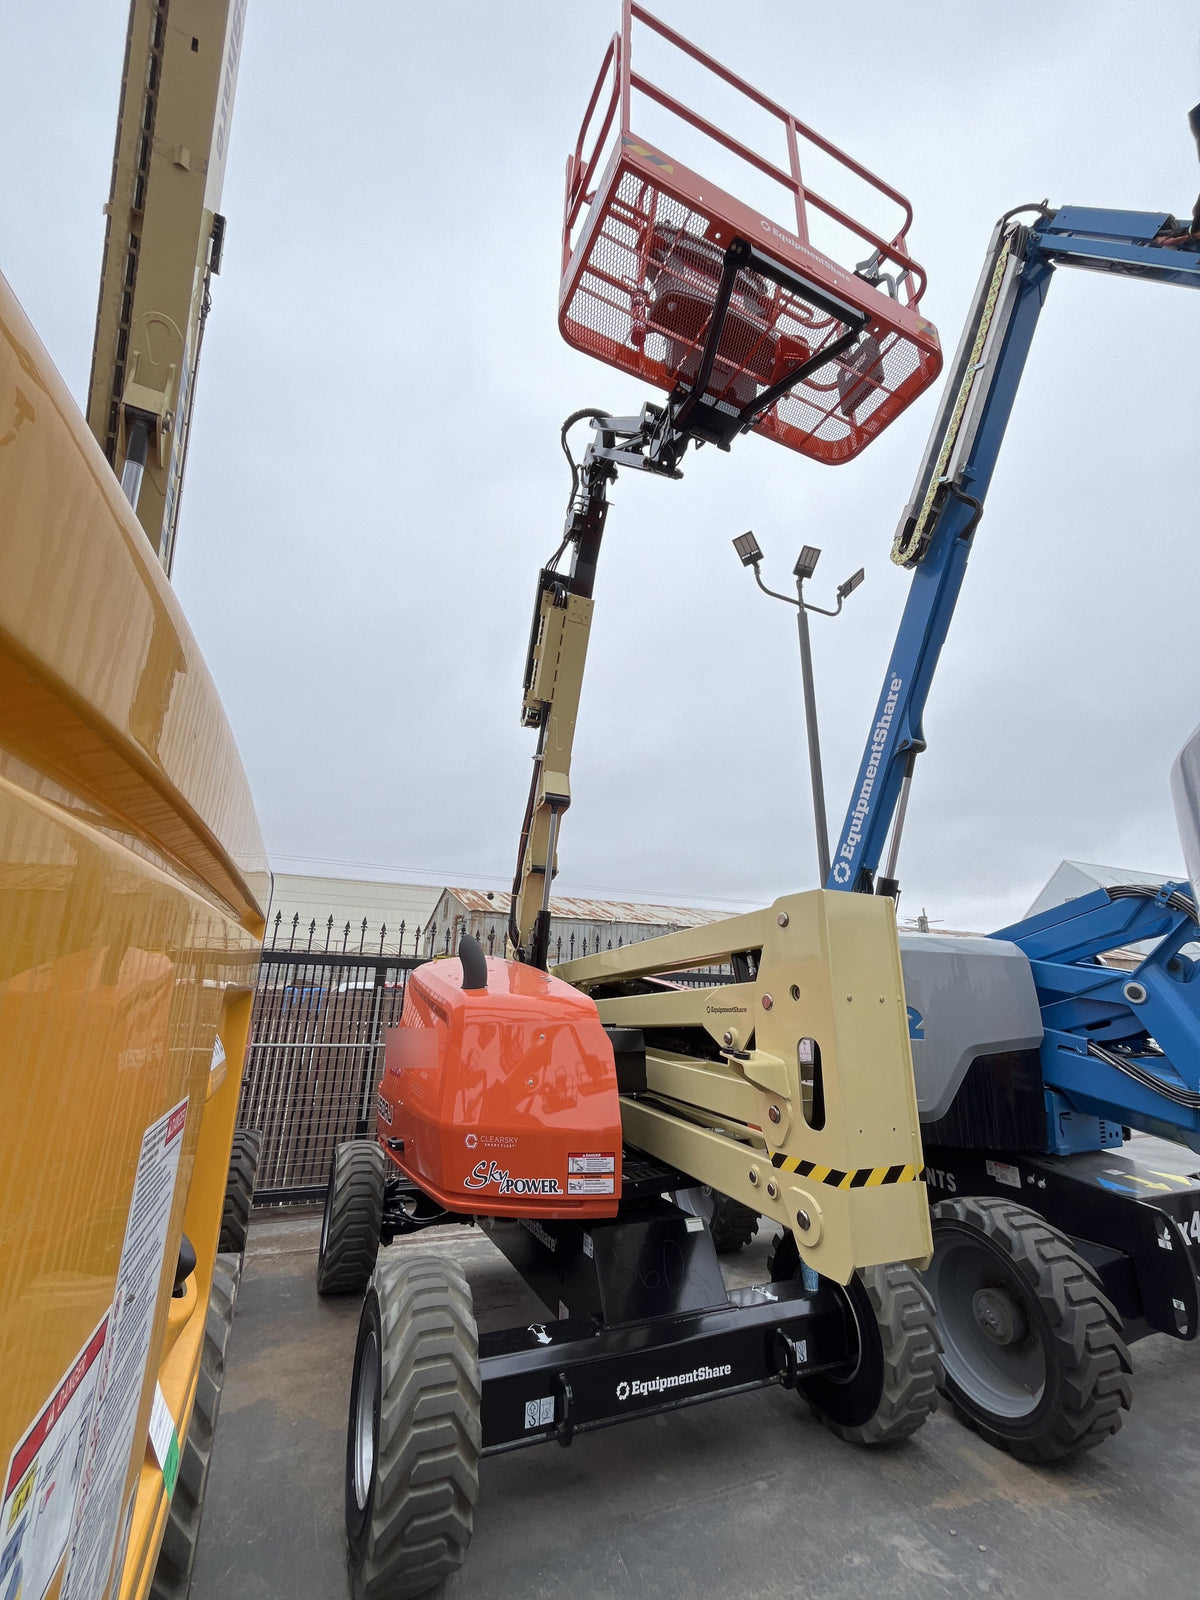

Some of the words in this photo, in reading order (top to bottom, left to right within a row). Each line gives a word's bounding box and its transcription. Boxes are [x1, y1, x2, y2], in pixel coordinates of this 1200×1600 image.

[772, 227, 851, 282] EquipmentShare
[711, 1006, 747, 1014] EquipmentShare
[480, 1136, 518, 1144] CLEARSKY
[631, 1364, 732, 1396] EquipmentShare
